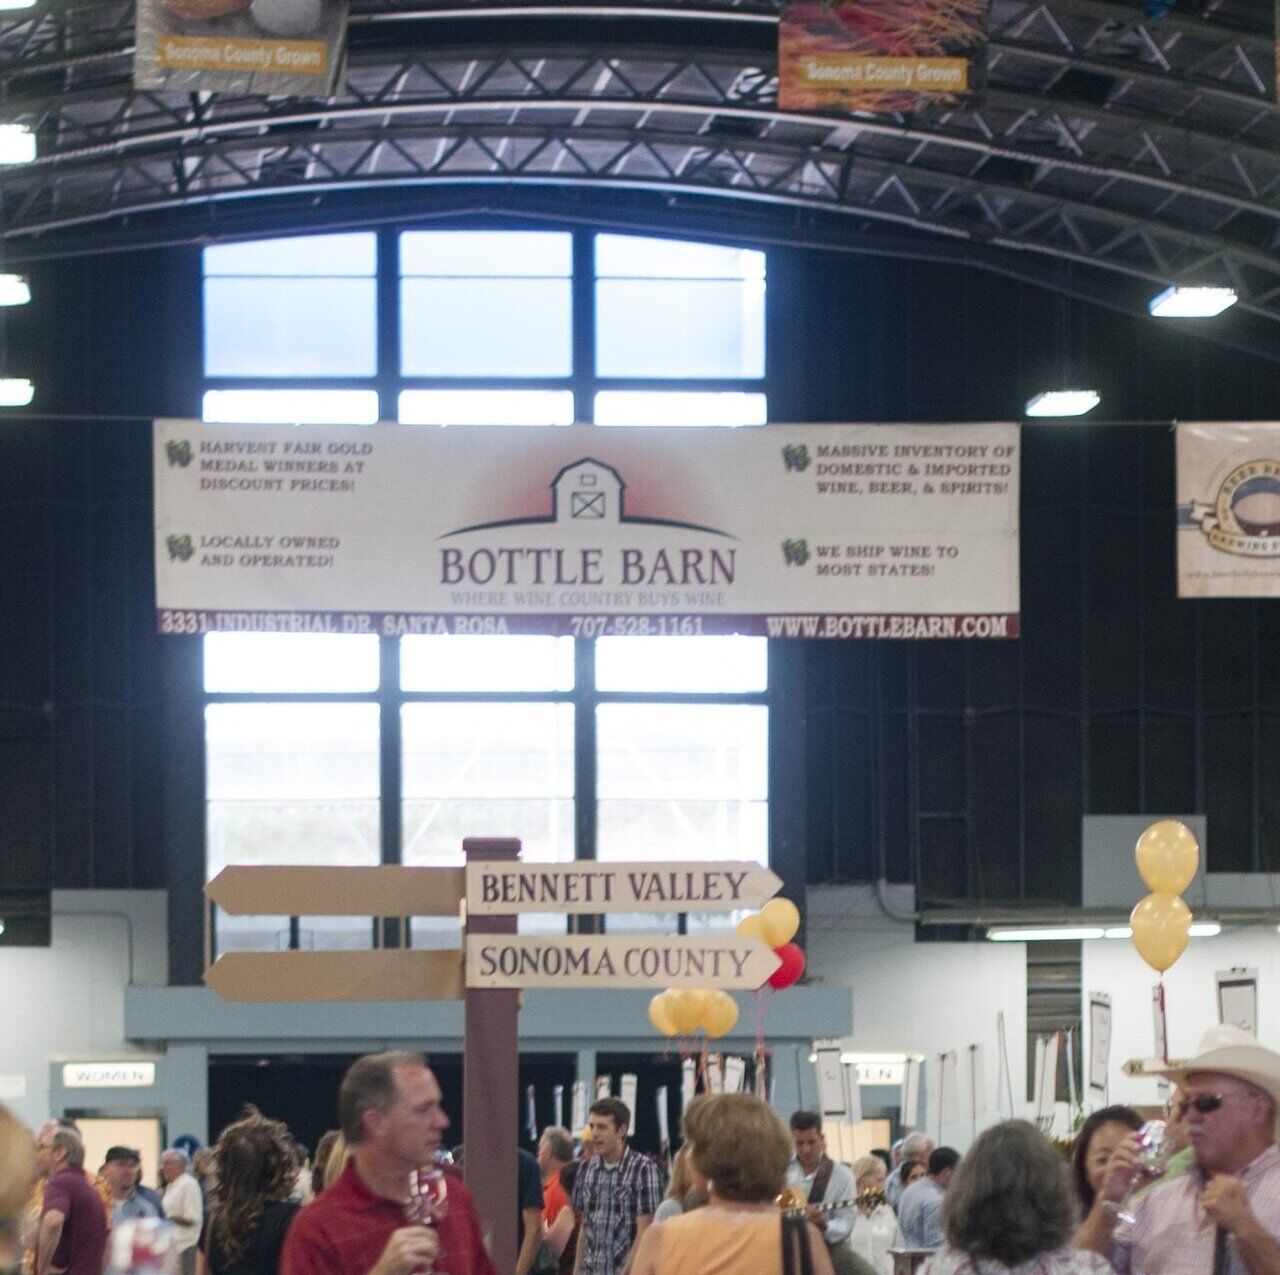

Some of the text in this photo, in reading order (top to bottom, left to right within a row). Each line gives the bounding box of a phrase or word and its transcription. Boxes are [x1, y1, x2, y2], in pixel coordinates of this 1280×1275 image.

[166, 42, 320, 67] Sonoma County Grown
[807, 62, 961, 86] Sonoma County Grown
[200, 441, 373, 456] HARVEST FAIR GOLD
[816, 445, 1015, 458] MASSIVE INVENTORY OF
[200, 459, 366, 474] MEDAL WINNERS AT
[816, 463, 1011, 476] DOMESTIC & IMPORTED
[200, 477, 356, 492] DISCOUNT PRICES!
[816, 481, 1009, 495] WINE, BEER, & SPIRITS!
[201, 536, 340, 550] LOCALLY OWNED
[816, 546, 959, 559] WE SHIP WINE TO
[201, 554, 334, 568] AND OPERATED!
[440, 547, 737, 586] BOTTLE BARN
[816, 564, 936, 577] MOST STATES!
[452, 591, 727, 607] WHERE WINE COUNTRY BUYS WINE
[162, 611, 208, 634] 3331
[215, 613, 336, 633] INDUSTRIAL
[383, 615, 449, 635] SANTA
[454, 616, 510, 636] ROSA
[570, 616, 704, 636] 707-528-1161
[767, 616, 1008, 639] WWW.BOTTLEBARN.COM
[481, 871, 751, 903] BENNETT VALLEY
[479, 945, 754, 979] SONOMA COUNTY
